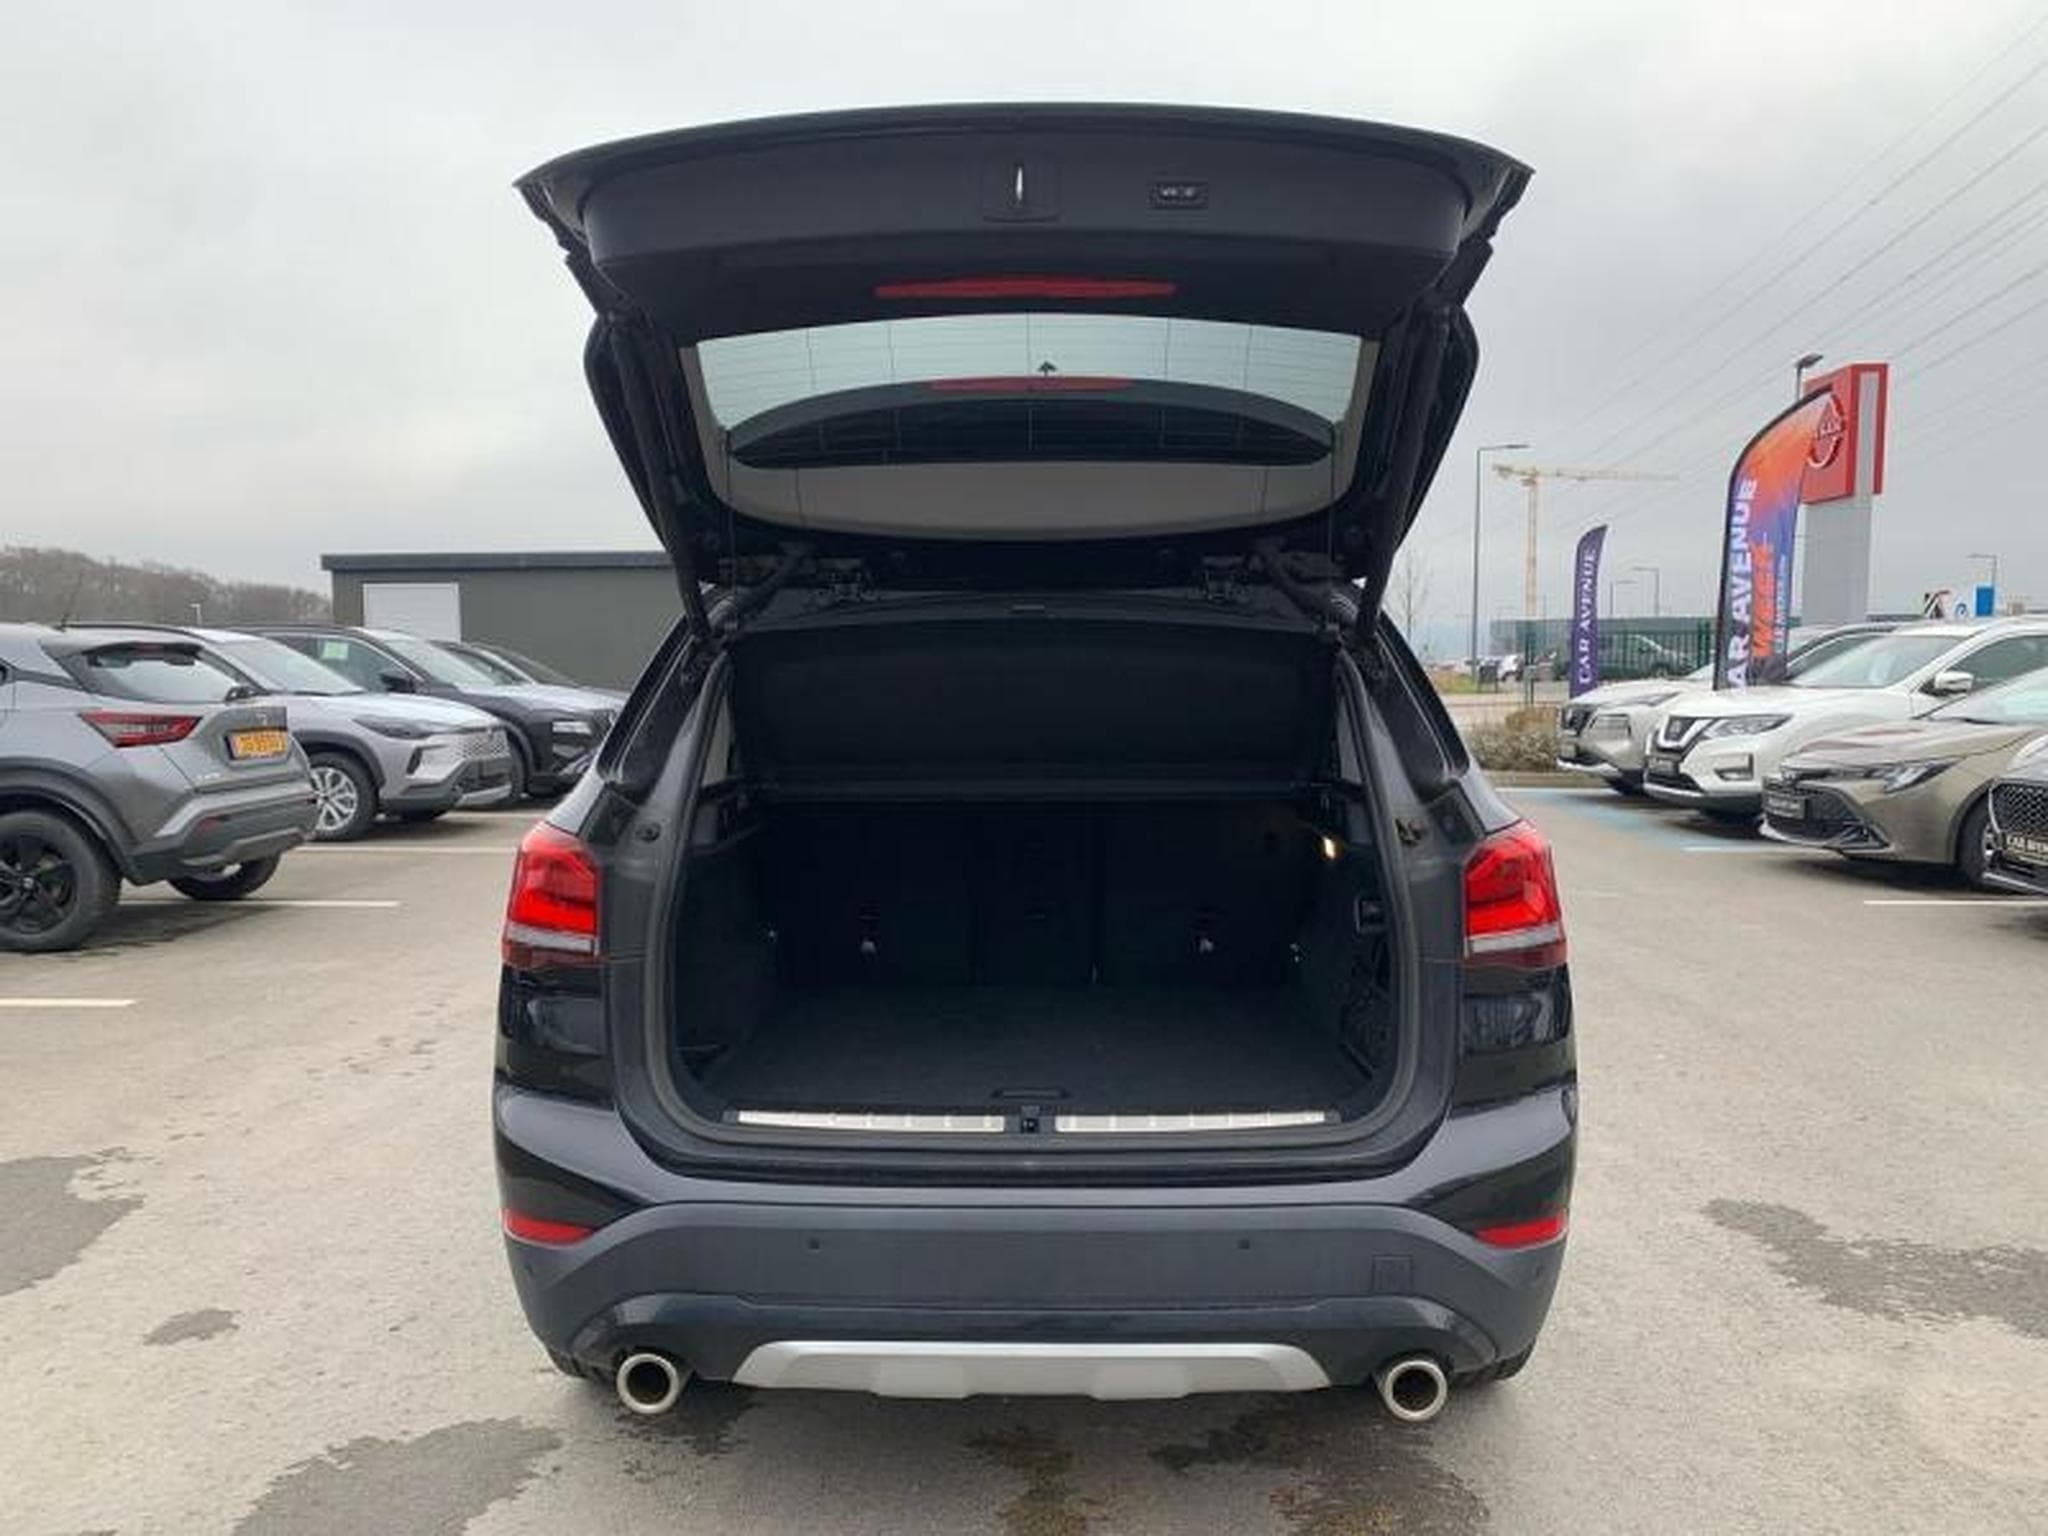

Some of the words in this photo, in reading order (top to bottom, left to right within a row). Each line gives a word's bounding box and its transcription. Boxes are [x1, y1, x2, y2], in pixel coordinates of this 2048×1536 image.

[1730, 478, 1757, 624] AVENUE
[1579, 547, 1596, 632] AVENUE
[1578, 637, 1592, 684] CAR
[1727, 634, 1750, 692] AR
